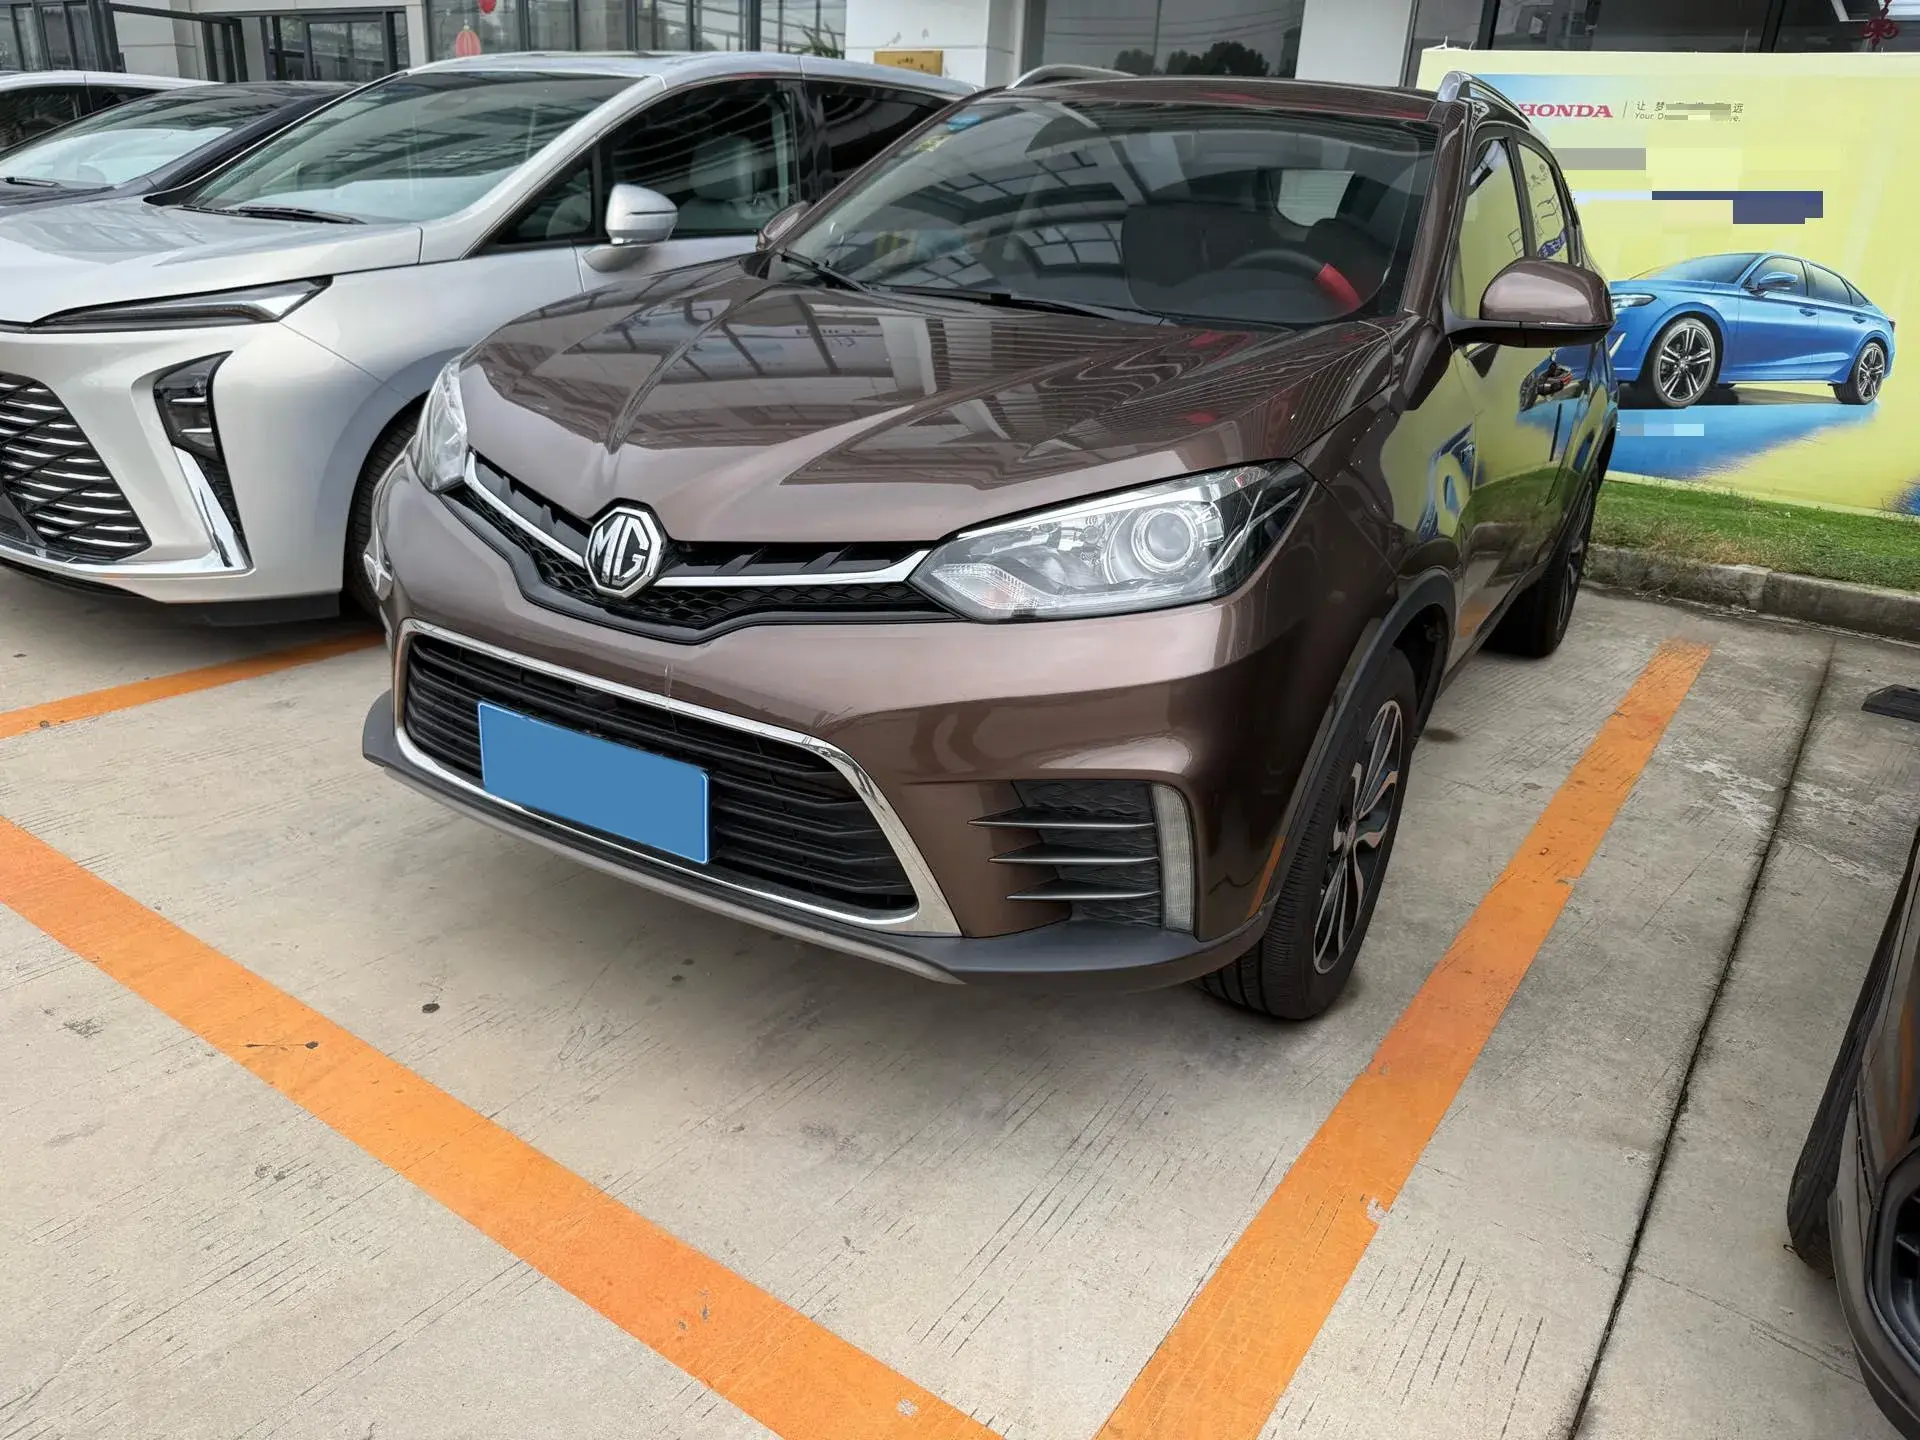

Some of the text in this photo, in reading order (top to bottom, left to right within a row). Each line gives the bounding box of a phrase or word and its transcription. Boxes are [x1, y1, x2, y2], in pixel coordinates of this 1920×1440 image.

[1518, 103, 1613, 118] HONDA
[1634, 112, 1654, 120] Your
[590, 515, 650, 587] MG
